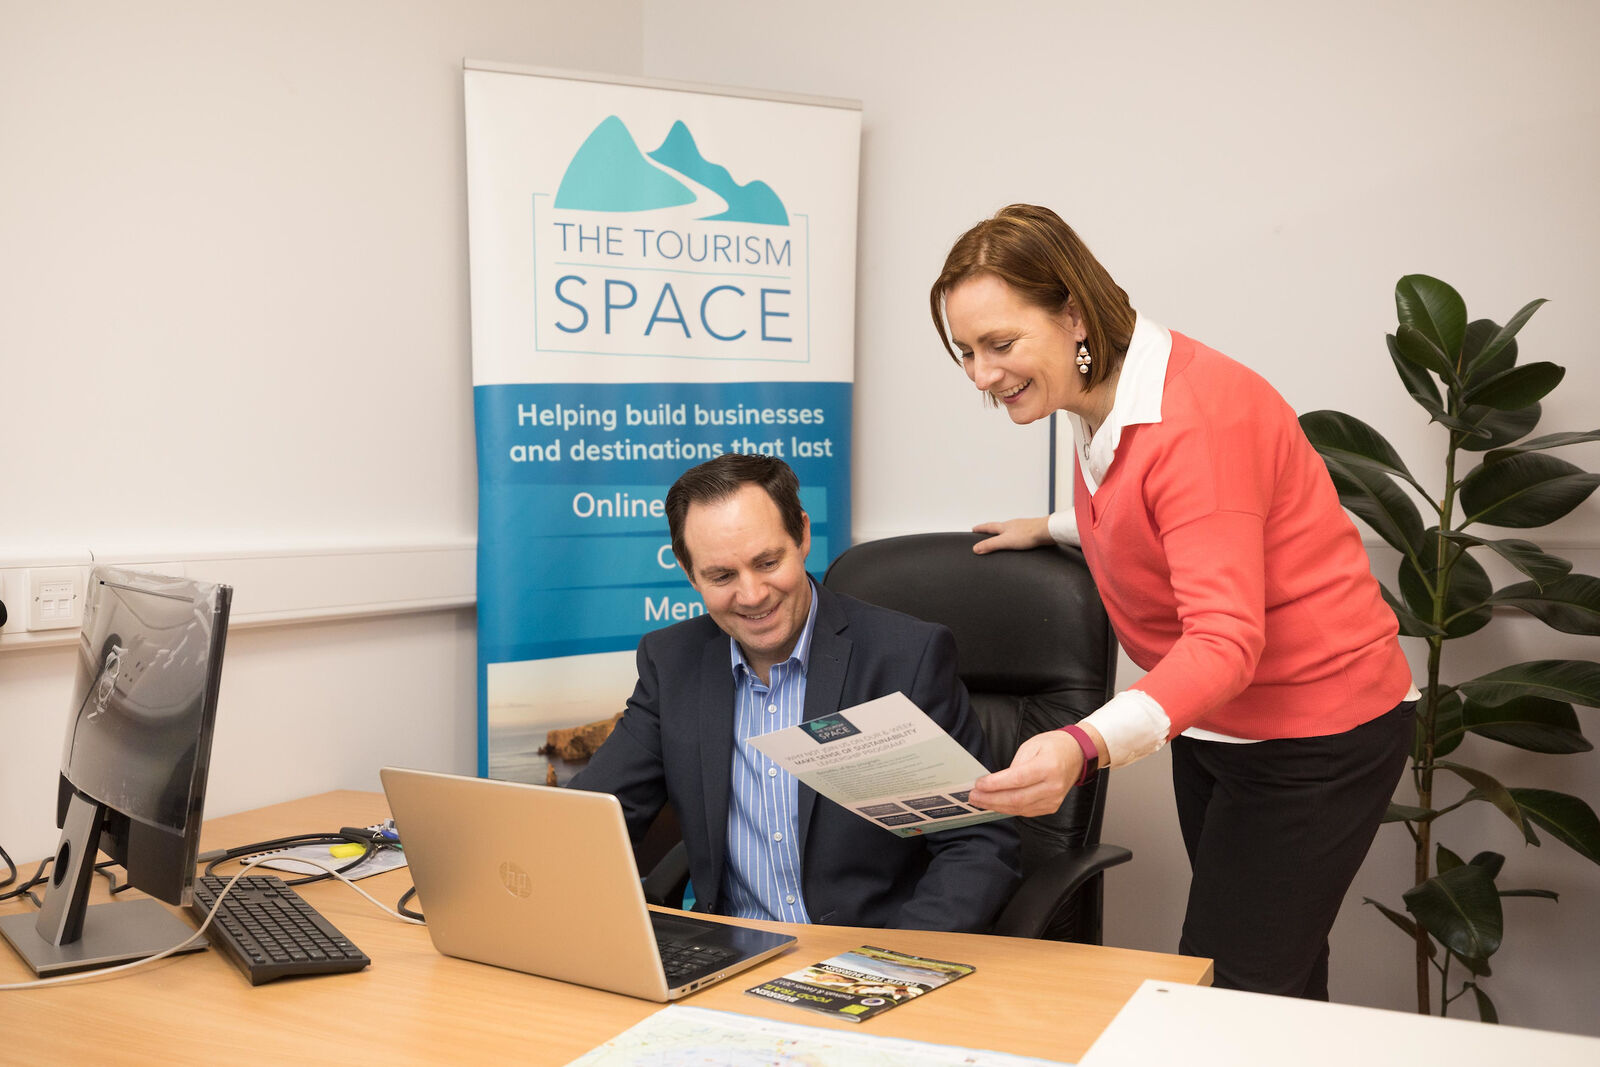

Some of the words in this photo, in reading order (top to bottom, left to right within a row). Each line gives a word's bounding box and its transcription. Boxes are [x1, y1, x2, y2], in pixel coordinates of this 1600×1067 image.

[553, 222, 624, 256] THE
[634, 228, 791, 267] TOURISM
[554, 274, 793, 343] SPACE
[518, 404, 617, 431] Helping
[626, 404, 686, 426] build
[694, 403, 824, 425] businesses
[510, 439, 560, 462] and
[570, 438, 723, 461] destinations
[731, 437, 784, 457] that
[792, 436, 833, 457] last
[572, 492, 665, 517] Online
[644, 596, 710, 620] Men
[819, 726, 851, 740] SPACE
[794, 757, 816, 766] MAKE
[817, 750, 840, 760] SENSE
[853, 729, 918, 750] SUSTAINABILITY
[822, 964, 864, 980] BURREN
[863, 973, 885, 983] THE
[750, 987, 800, 1003] BURREN
[763, 983, 797, 996] TRAIL
[796, 992, 833, 1004] FOOD
